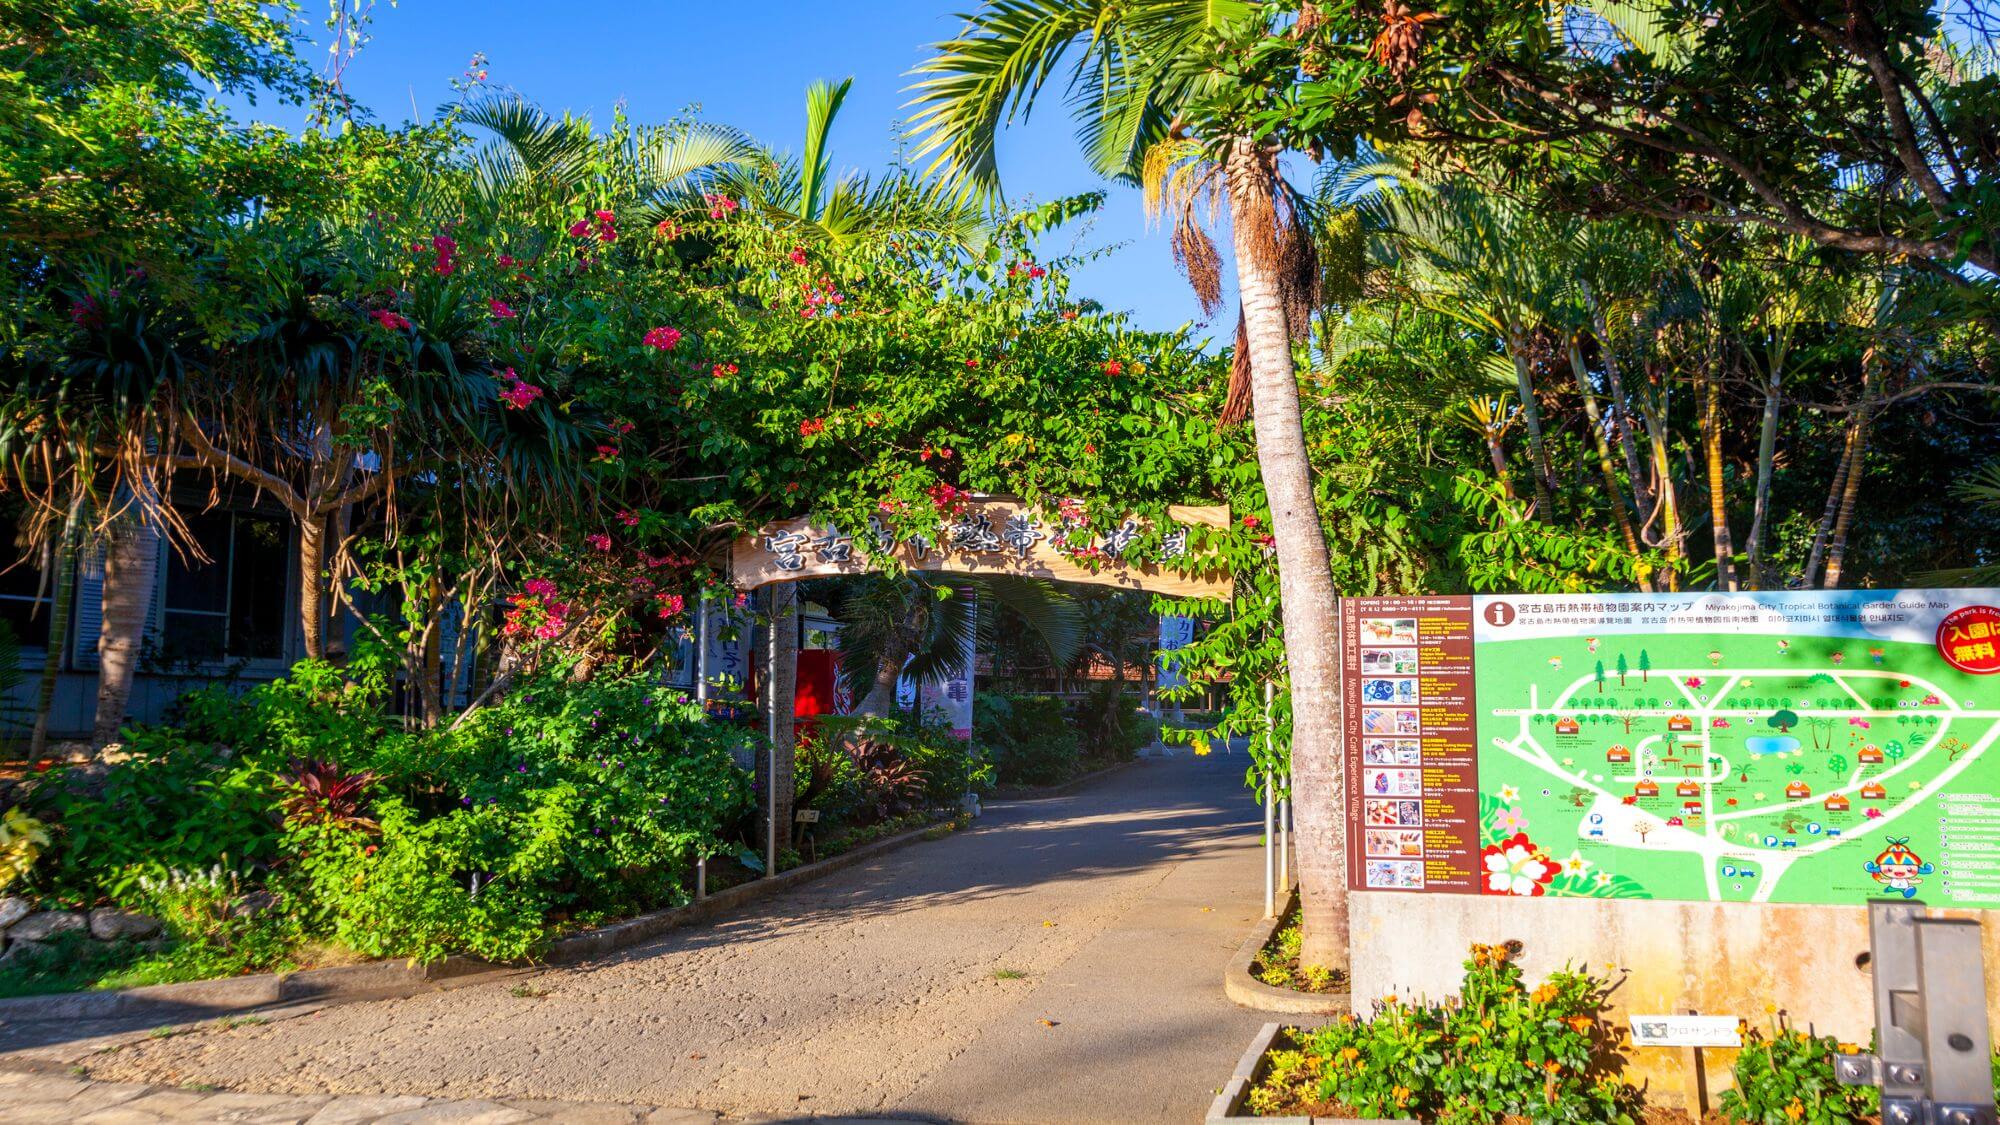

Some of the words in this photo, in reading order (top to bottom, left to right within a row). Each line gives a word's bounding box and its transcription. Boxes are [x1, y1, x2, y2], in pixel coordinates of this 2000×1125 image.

[1518, 602, 1694, 613] 宮古島市熱帯植物園案内マップ
[1705, 603, 1756, 612] Miyakojima
[1758, 603, 1777, 611] City
[1779, 603, 1816, 611] Tropical
[1817, 602, 1860, 610] Botanical
[1898, 601, 1926, 609] Guide
[1928, 602, 1950, 611] Map
[1959, 608, 1977, 618] park
[1952, 641, 1996, 663] 無料
[1347, 678, 1357, 719] Miyakojima
[1348, 720, 1357, 735] City
[1349, 736, 1358, 755] Craft
[1349, 756, 1358, 795] Experience
[1349, 796, 1359, 821] Village
